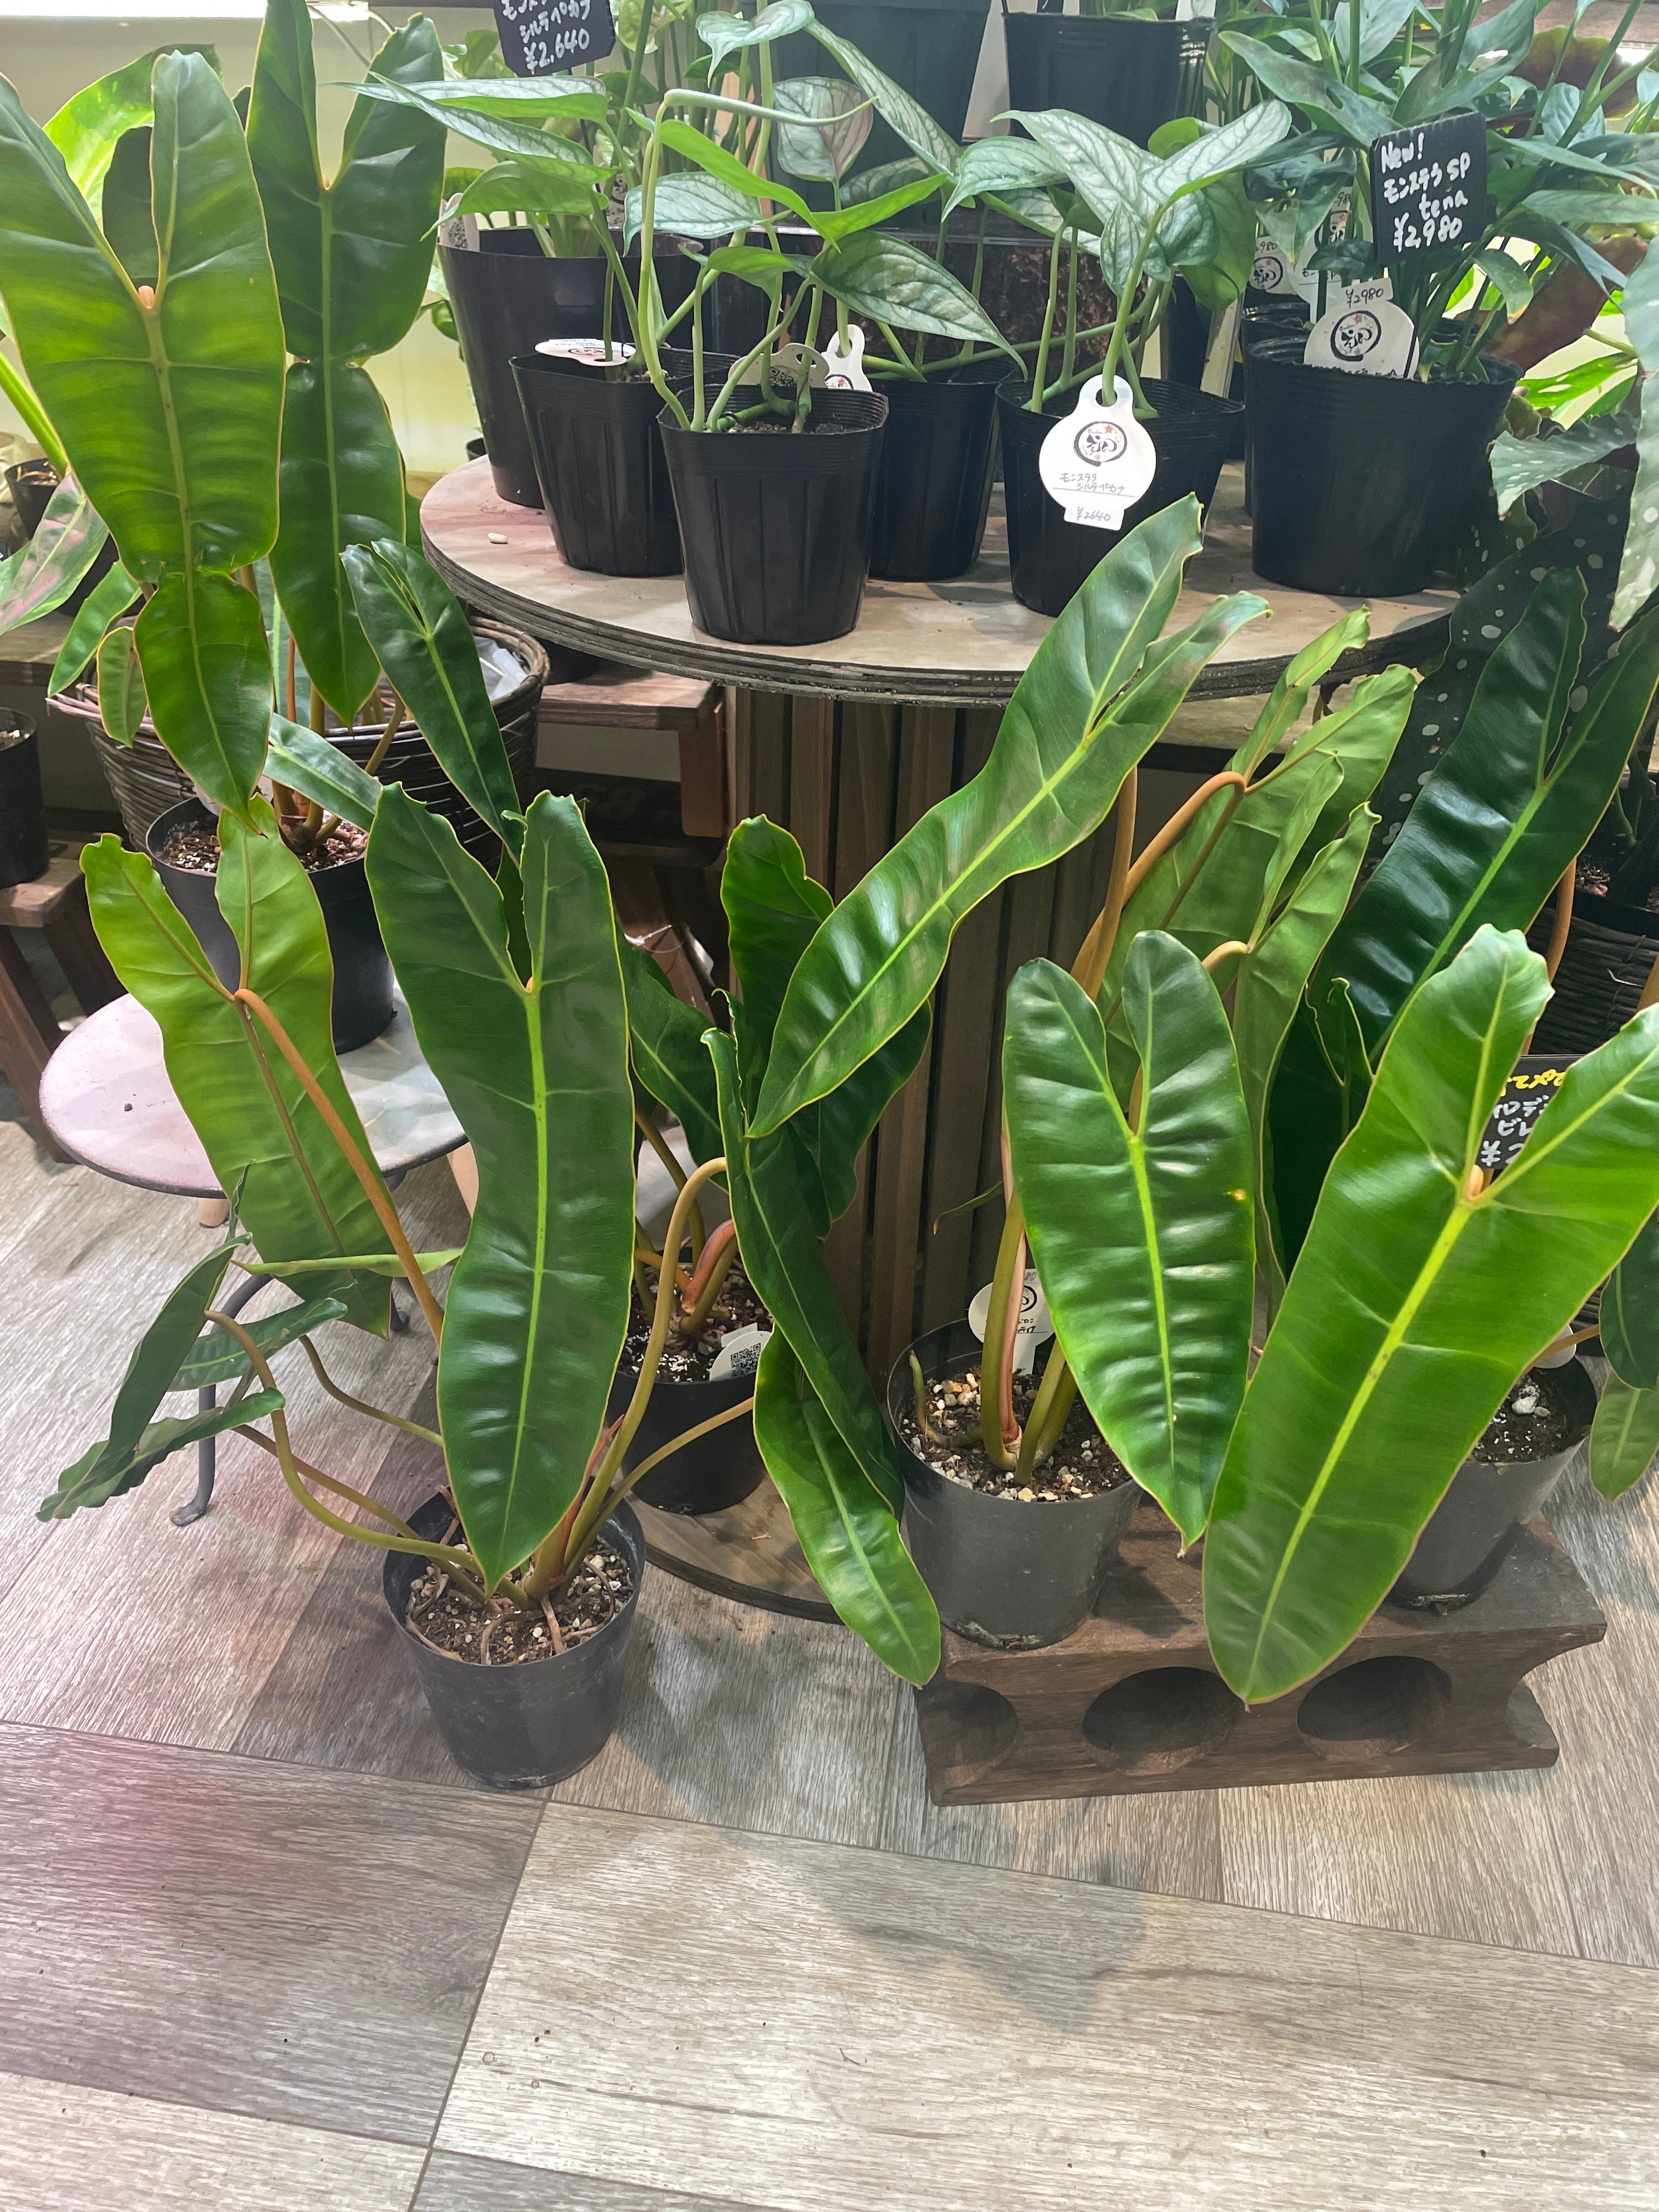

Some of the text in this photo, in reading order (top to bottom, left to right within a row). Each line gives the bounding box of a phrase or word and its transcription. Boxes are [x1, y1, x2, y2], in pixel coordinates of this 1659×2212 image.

[1381, 132, 1425, 174] New!
[1419, 190, 1469, 221] tena
[1345, 287, 1384, 309] ¥2980
[1076, 506, 1111, 521] ¥2640
